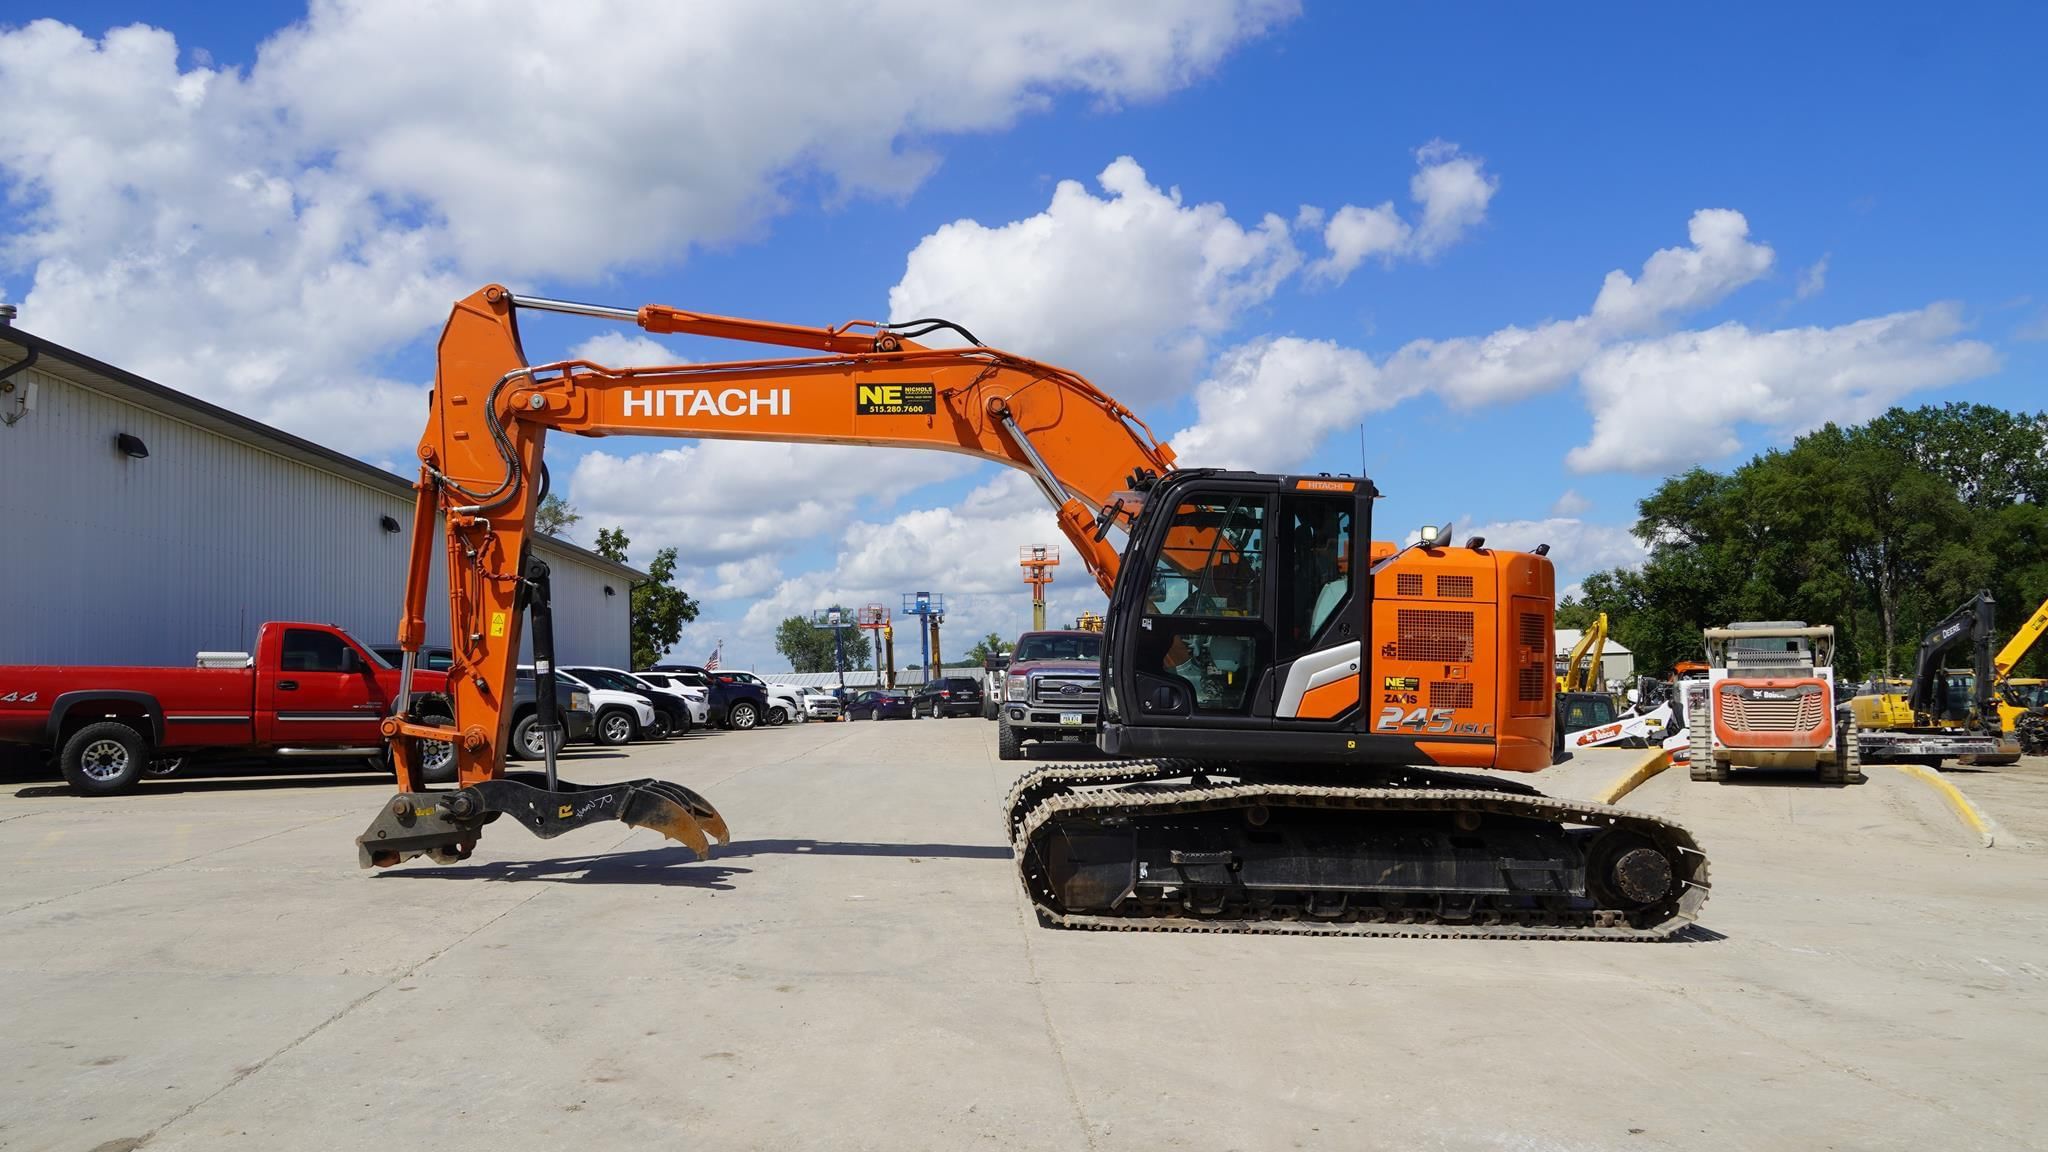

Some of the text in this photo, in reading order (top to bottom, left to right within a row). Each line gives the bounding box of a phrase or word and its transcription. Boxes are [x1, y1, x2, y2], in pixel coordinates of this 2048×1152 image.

[859, 385, 902, 404] NE
[623, 389, 791, 416] HITACHI
[869, 405, 923, 413] 515.280.7600
[1308, 480, 1344, 489] HITACHI
[1942, 623, 1961, 639] DEERE
[1385, 678, 1405, 687] NE
[1384, 693, 1418, 704] ZAXIS
[1377, 707, 1455, 733] 245
